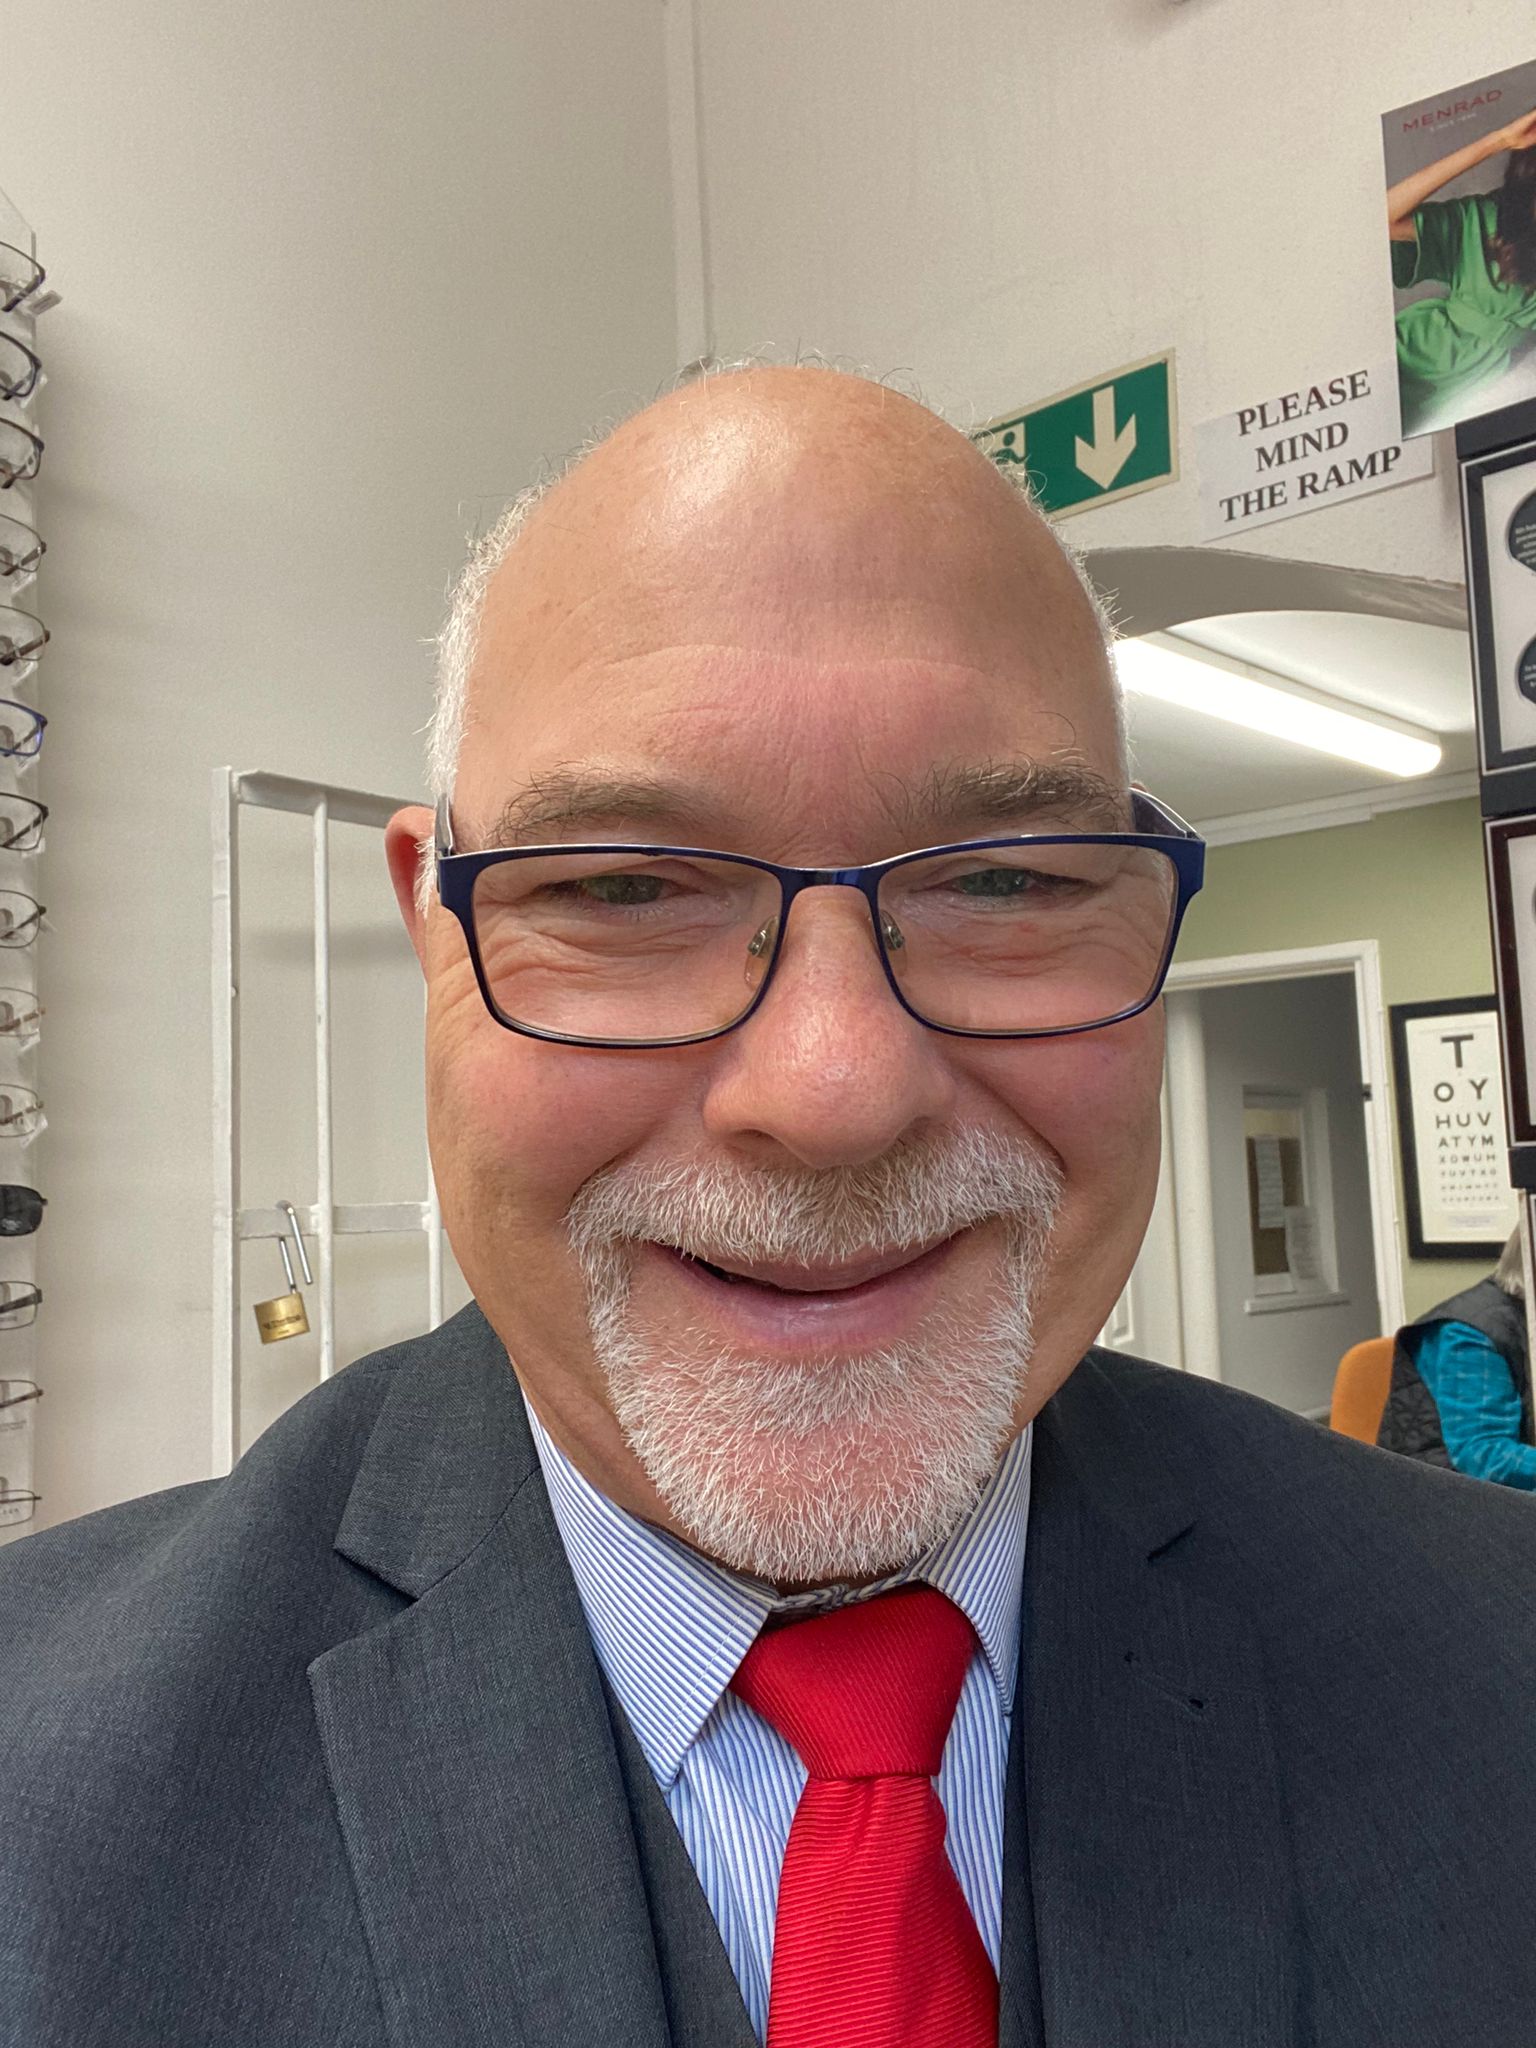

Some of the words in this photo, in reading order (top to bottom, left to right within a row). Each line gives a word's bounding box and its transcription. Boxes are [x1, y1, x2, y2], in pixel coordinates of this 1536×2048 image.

[1402, 89, 1502, 133] MENRAD
[1236, 369, 1371, 437] PLEASE
[1254, 421, 1349, 473] MIND
[1218, 480, 1288, 523] THE
[1296, 445, 1402, 501] RAMP
[1440, 1033, 1475, 1069] T
